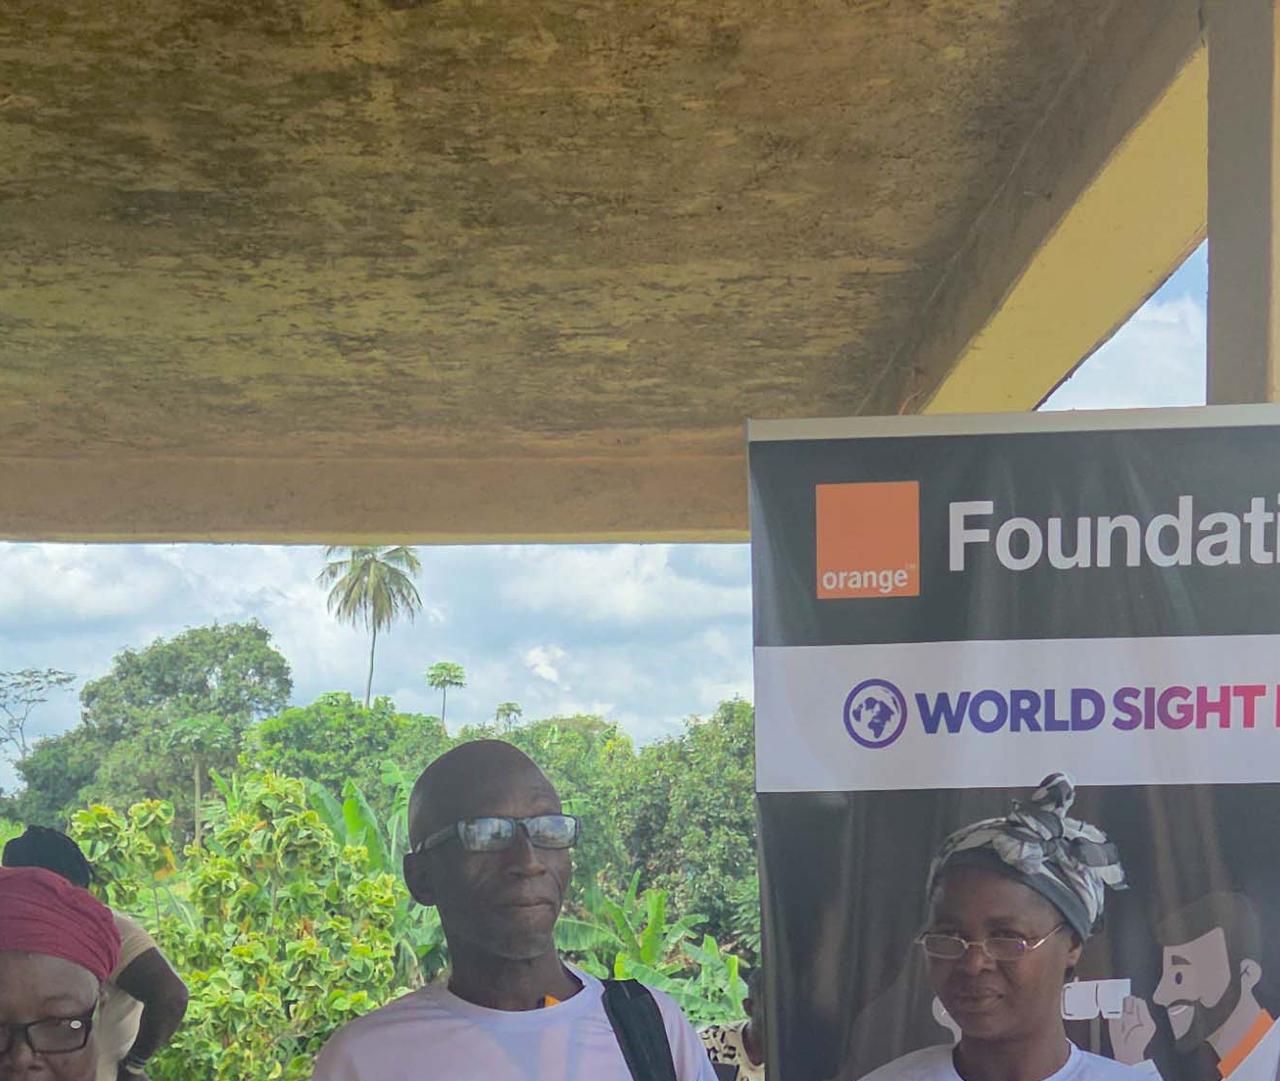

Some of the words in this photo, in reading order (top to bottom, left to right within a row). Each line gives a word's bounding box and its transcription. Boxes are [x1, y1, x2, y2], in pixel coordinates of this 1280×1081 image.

[822, 568, 909, 594] orange
[915, 687, 1106, 735] WORLD
[1112, 684, 1266, 731] SIGHT
